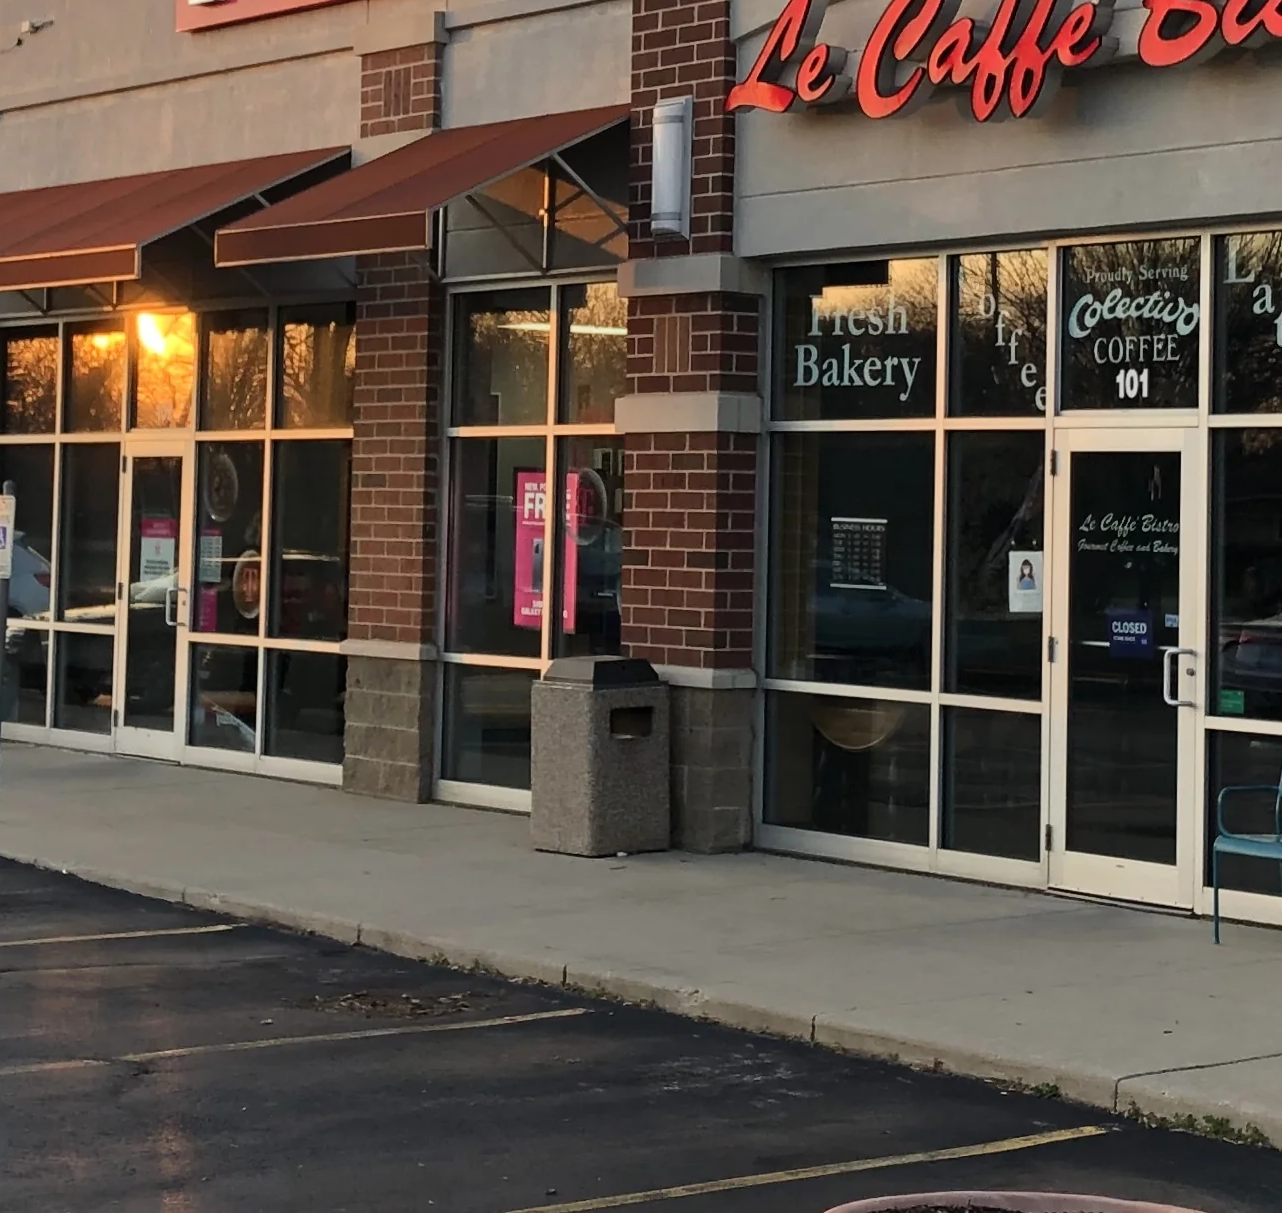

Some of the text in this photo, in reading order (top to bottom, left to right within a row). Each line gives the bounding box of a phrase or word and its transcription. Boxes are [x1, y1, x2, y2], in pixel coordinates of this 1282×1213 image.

[1085, 263, 1190, 284] Proudly Serving
[807, 293, 909, 337] Fresh
[1069, 288, 1200, 338] Colectivo
[1093, 333, 1180, 364] COFFEE
[793, 343, 922, 402] Bakery
[1115, 367, 1149, 399] 101
[1078, 514, 1096, 532] Le
[1141, 513, 1180, 533] Bistro
[1111, 621, 1148, 635] CLOSED
